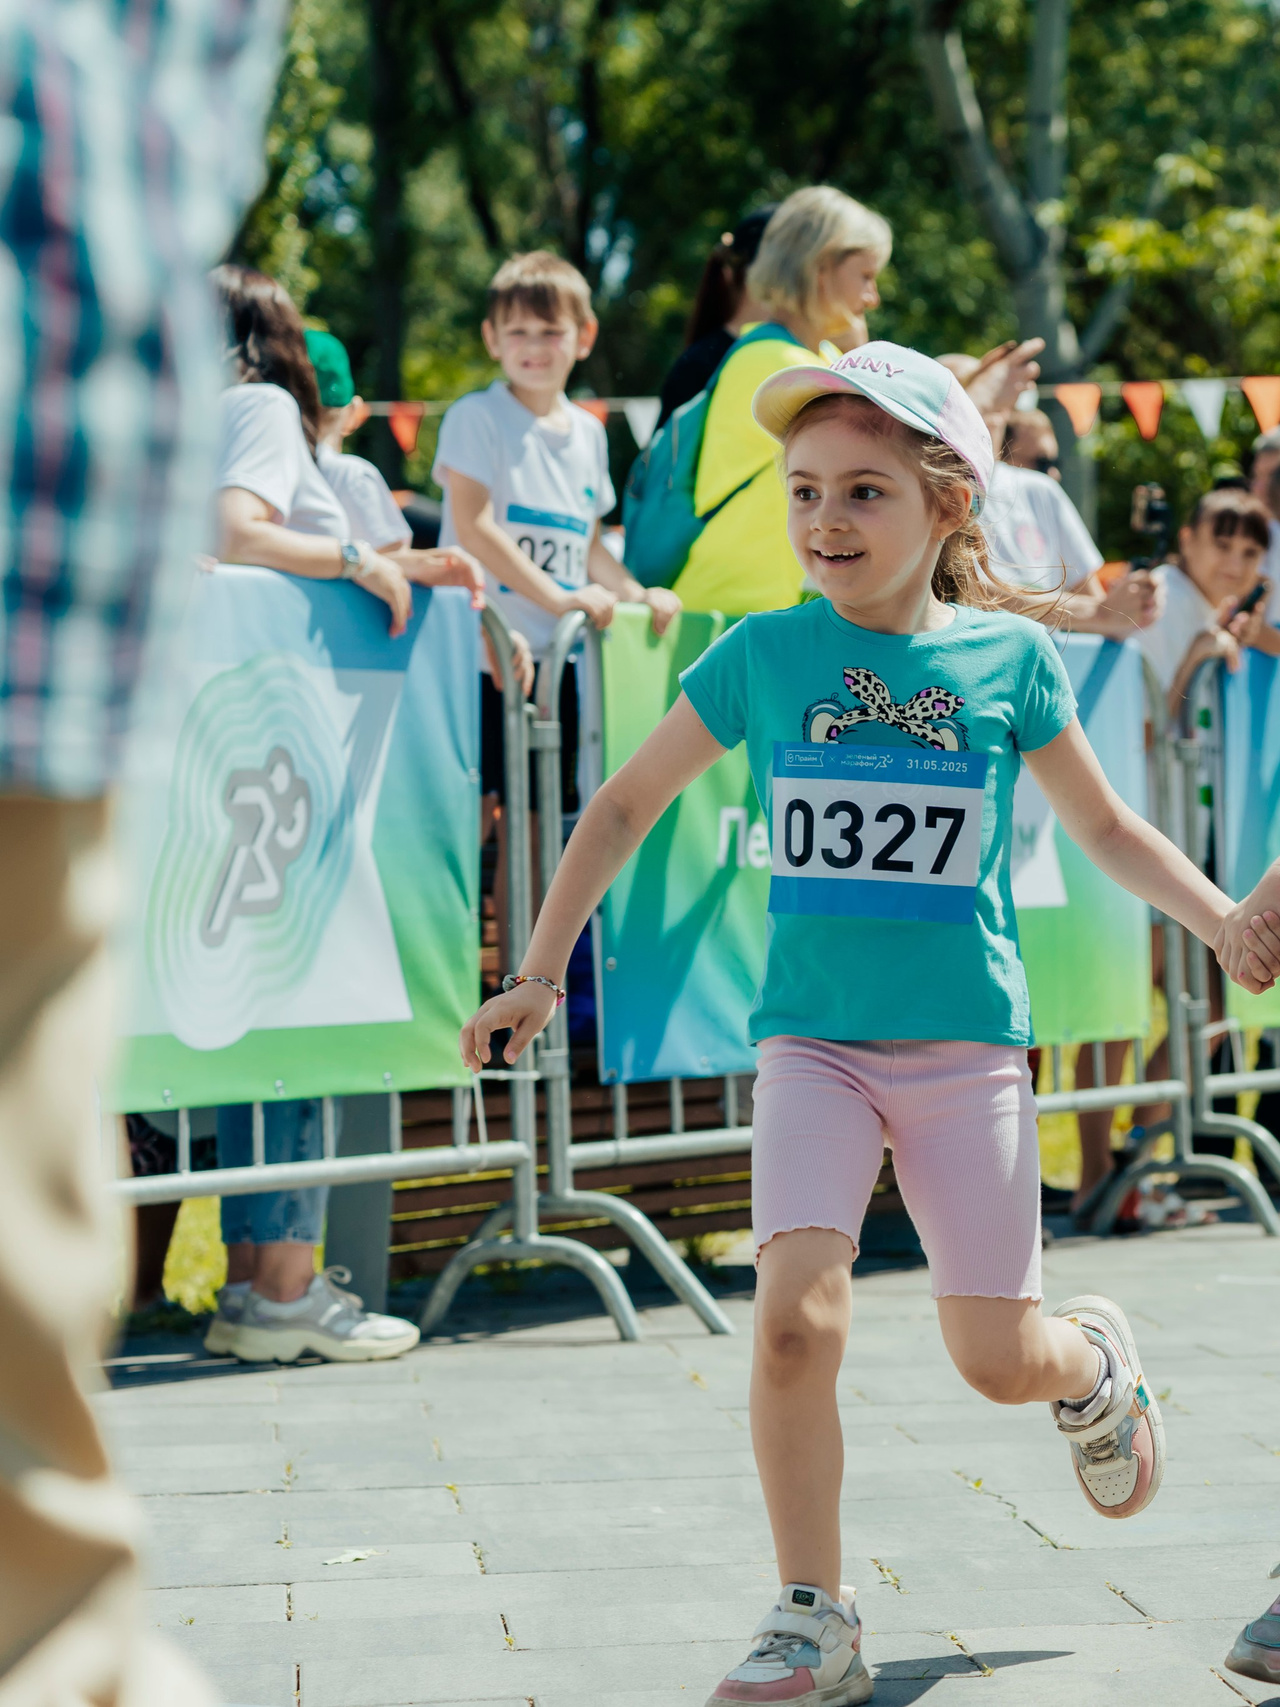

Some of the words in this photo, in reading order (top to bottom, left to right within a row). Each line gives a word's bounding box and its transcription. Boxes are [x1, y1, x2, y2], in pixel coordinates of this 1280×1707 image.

[841, 760, 874, 768] марафон
[906, 758, 968, 773] 31.05.2025
[784, 798, 966, 875] 0327
